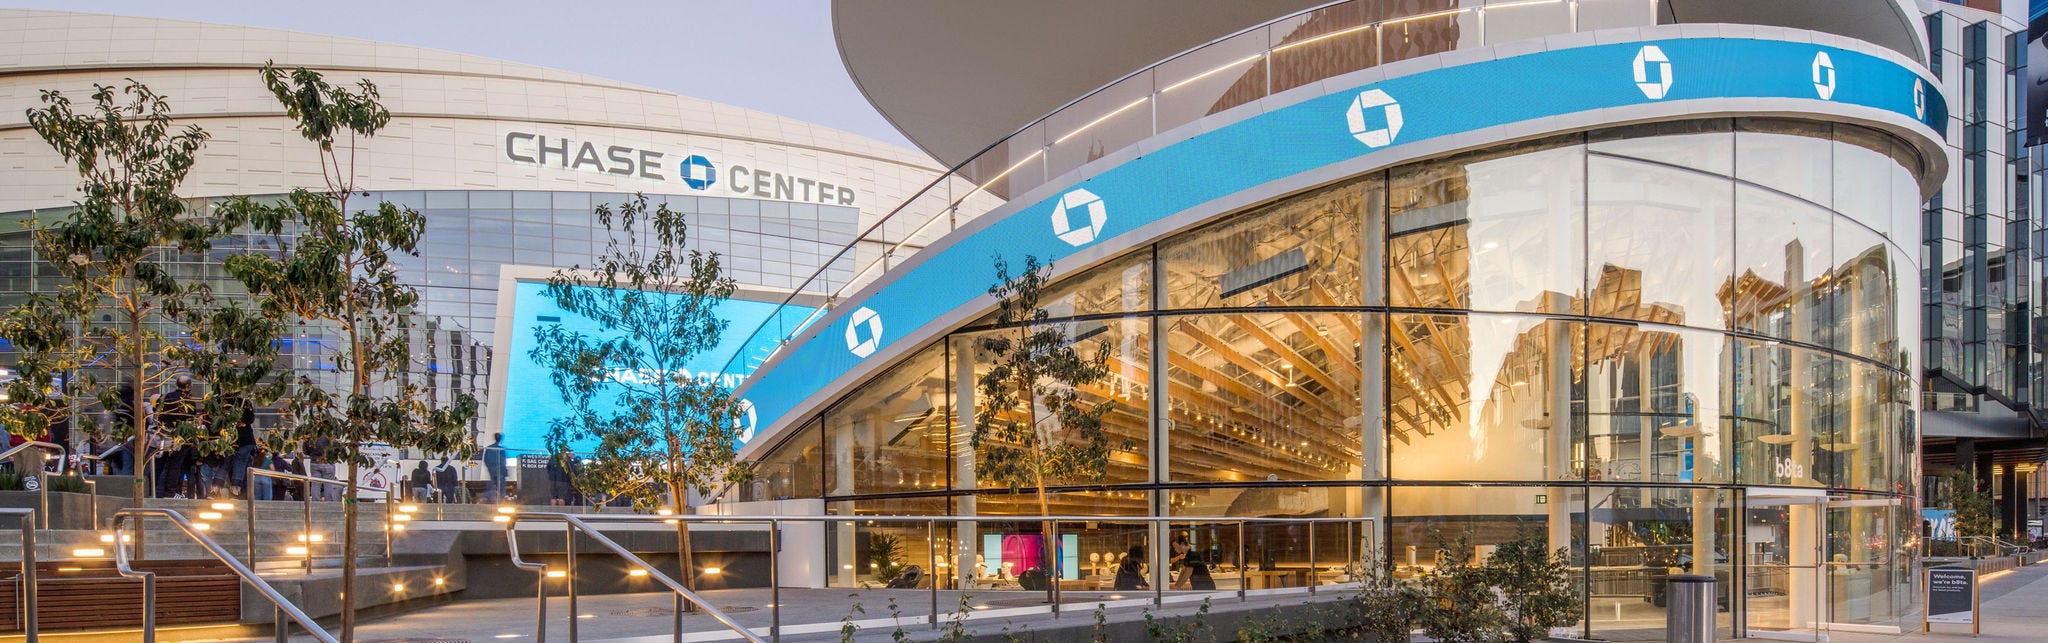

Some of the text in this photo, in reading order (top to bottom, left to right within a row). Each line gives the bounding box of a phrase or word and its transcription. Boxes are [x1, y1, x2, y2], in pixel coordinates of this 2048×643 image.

[506, 131, 855, 206] CHASE CENTER
[698, 371, 752, 388] CENT
[1775, 456, 1804, 478] b8ta
